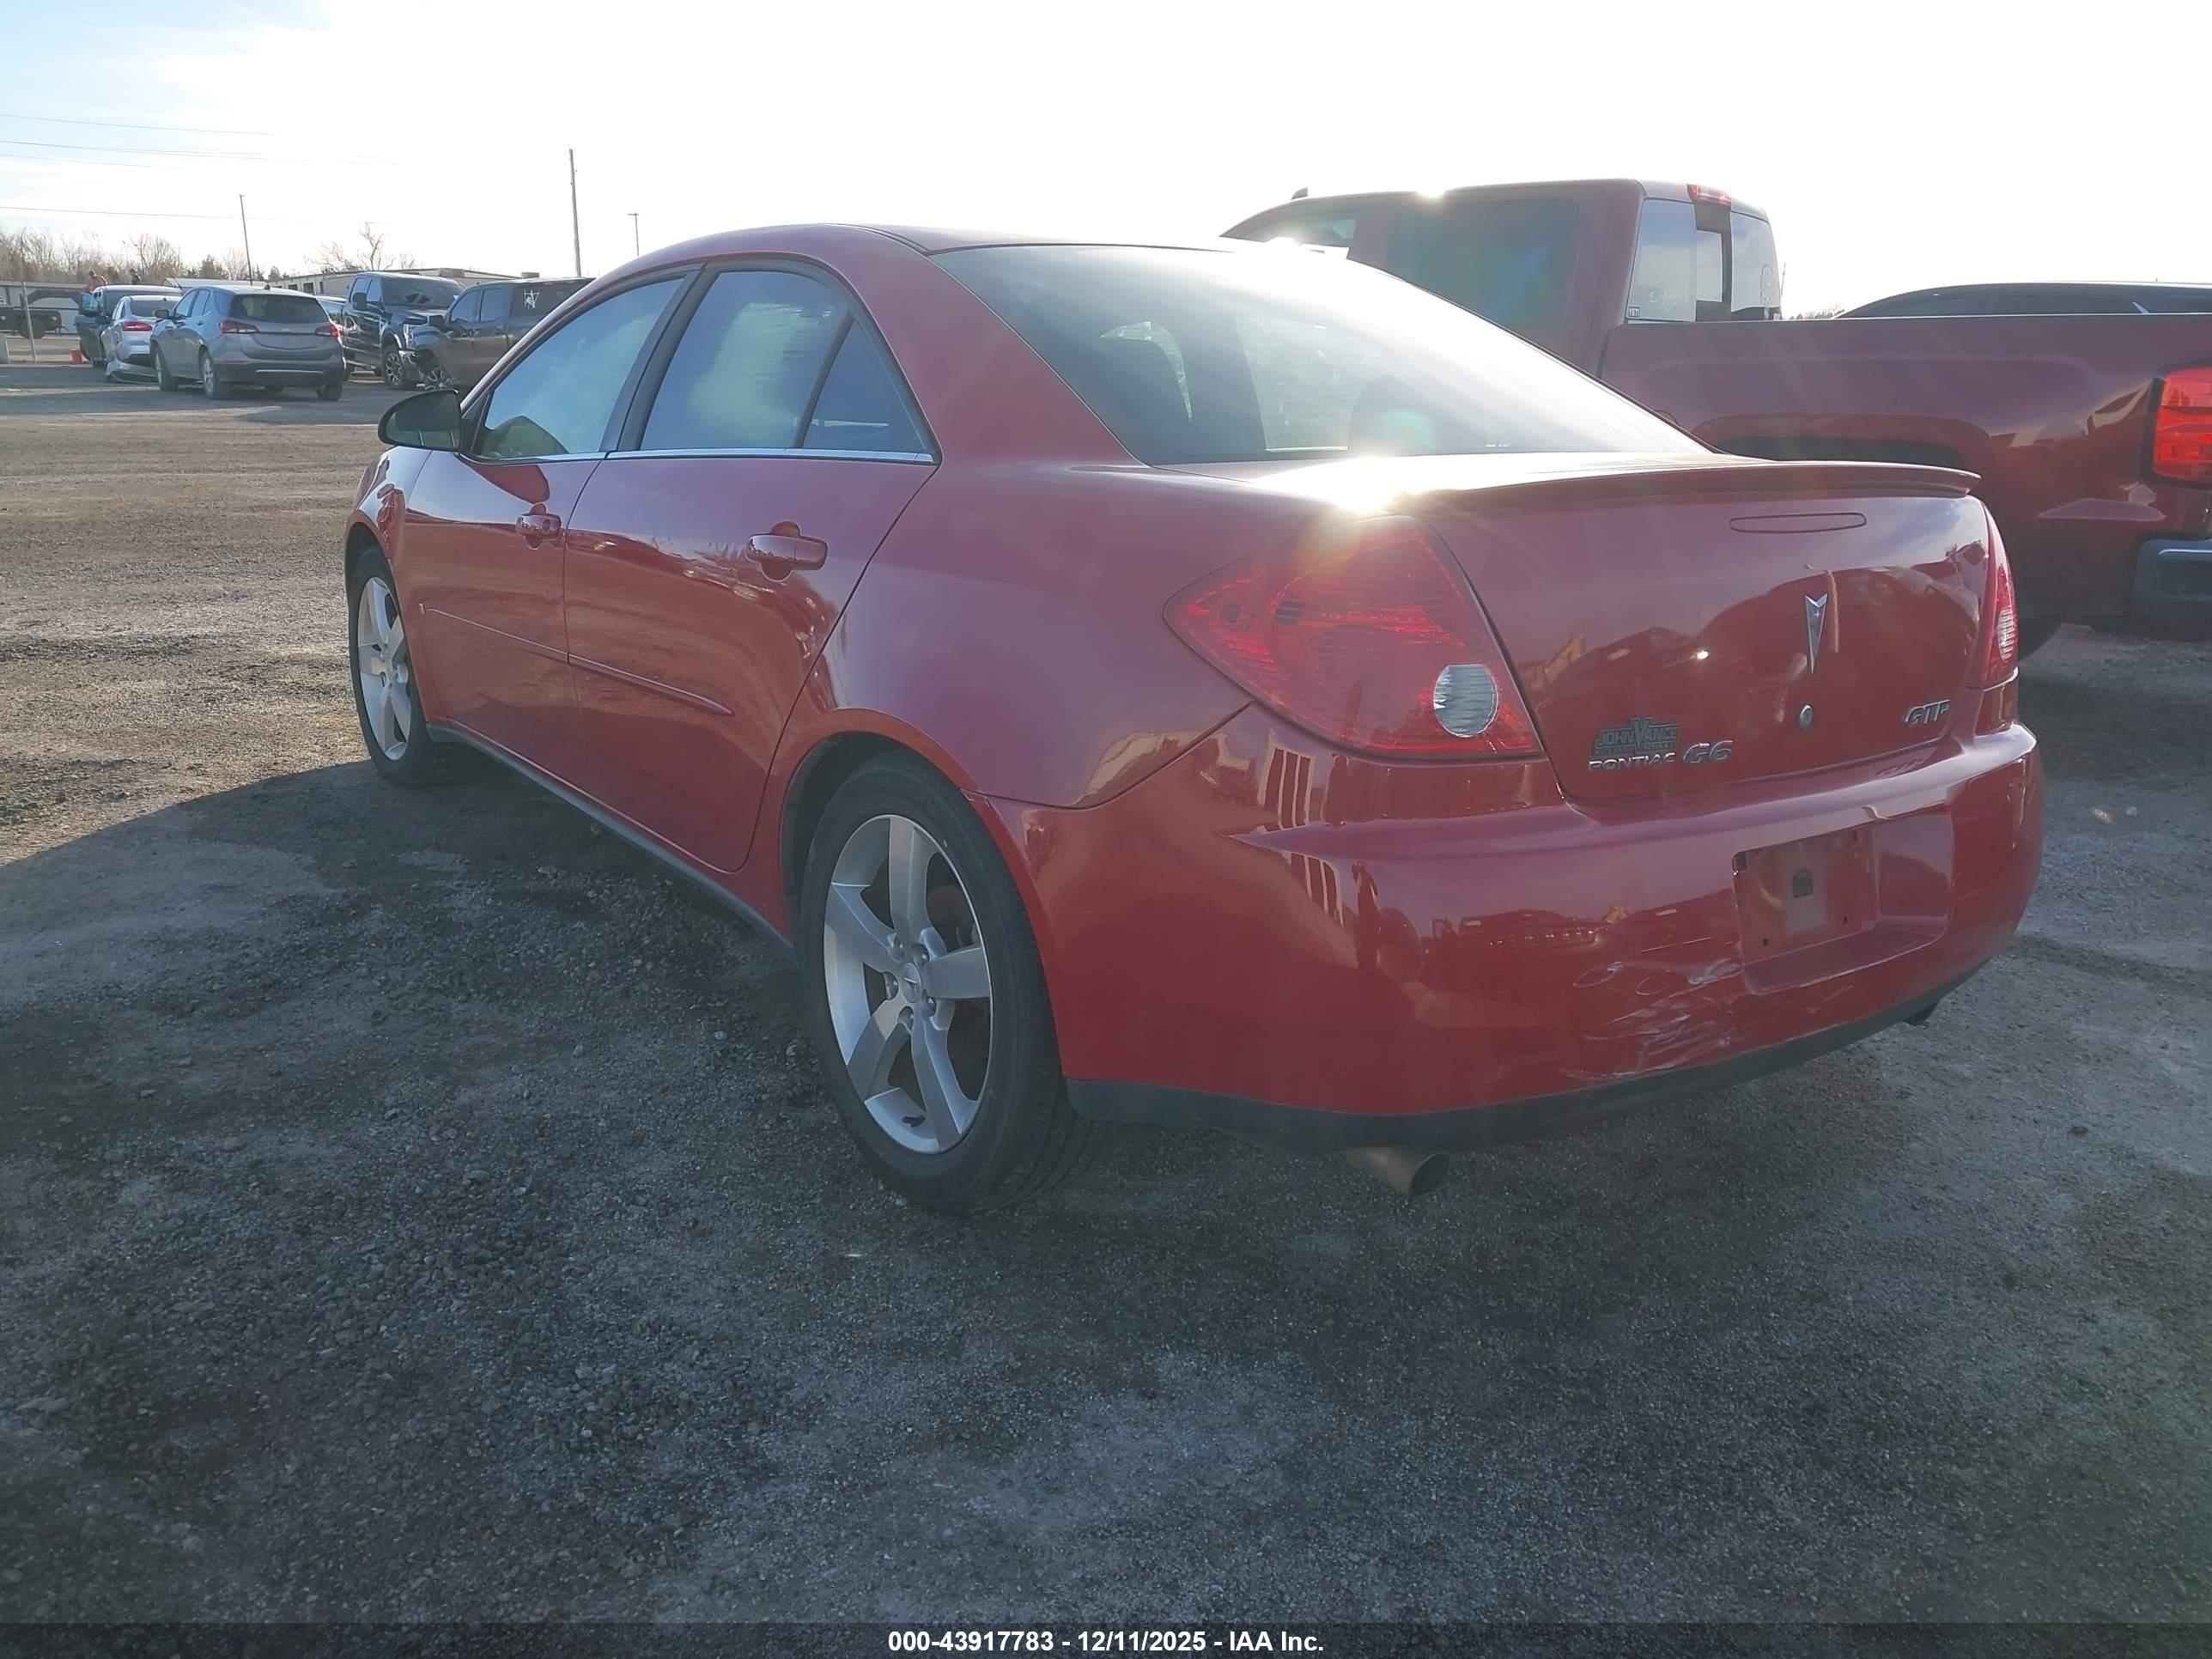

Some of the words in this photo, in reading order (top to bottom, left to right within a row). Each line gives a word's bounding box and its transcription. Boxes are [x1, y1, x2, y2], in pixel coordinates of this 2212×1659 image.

[1904, 699, 1951, 726] GTP
[1597, 728, 1634, 747] JOHN
[1632, 718, 1678, 750] VANCE
[1589, 752, 1676, 771] PONTIAC
[1683, 739, 1735, 763] G6
